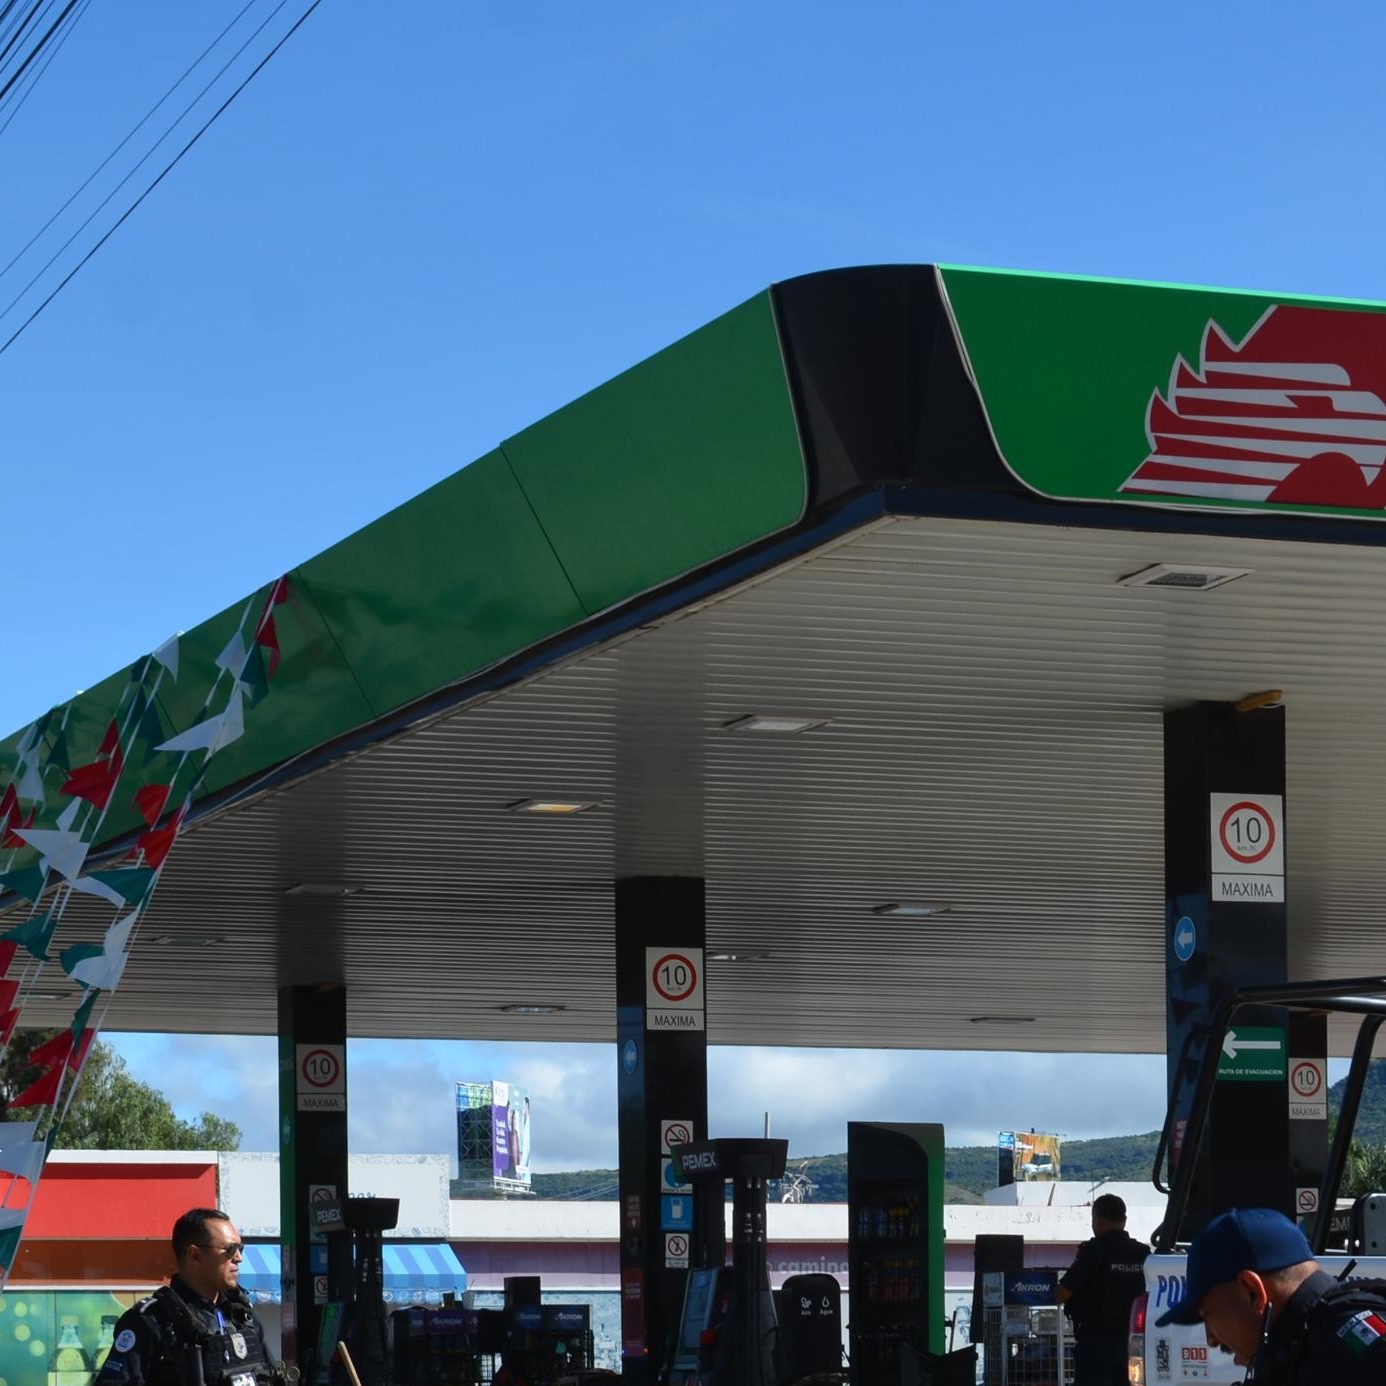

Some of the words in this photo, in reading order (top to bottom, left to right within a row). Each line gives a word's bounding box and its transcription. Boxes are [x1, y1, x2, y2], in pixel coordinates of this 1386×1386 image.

[1230, 817, 1262, 844] 10
[1222, 882, 1273, 898] MAXIMA
[661, 965, 687, 987] 10
[654, 1015, 696, 1027] MAXIMA
[309, 1058, 331, 1076] 10
[1297, 1070, 1315, 1086] 10
[303, 1098, 339, 1108] MAXIMA
[1291, 1107, 1321, 1117] MAXIMA
[682, 1151, 716, 1171] PEMEX
[1012, 1281, 1051, 1292] AKRON
